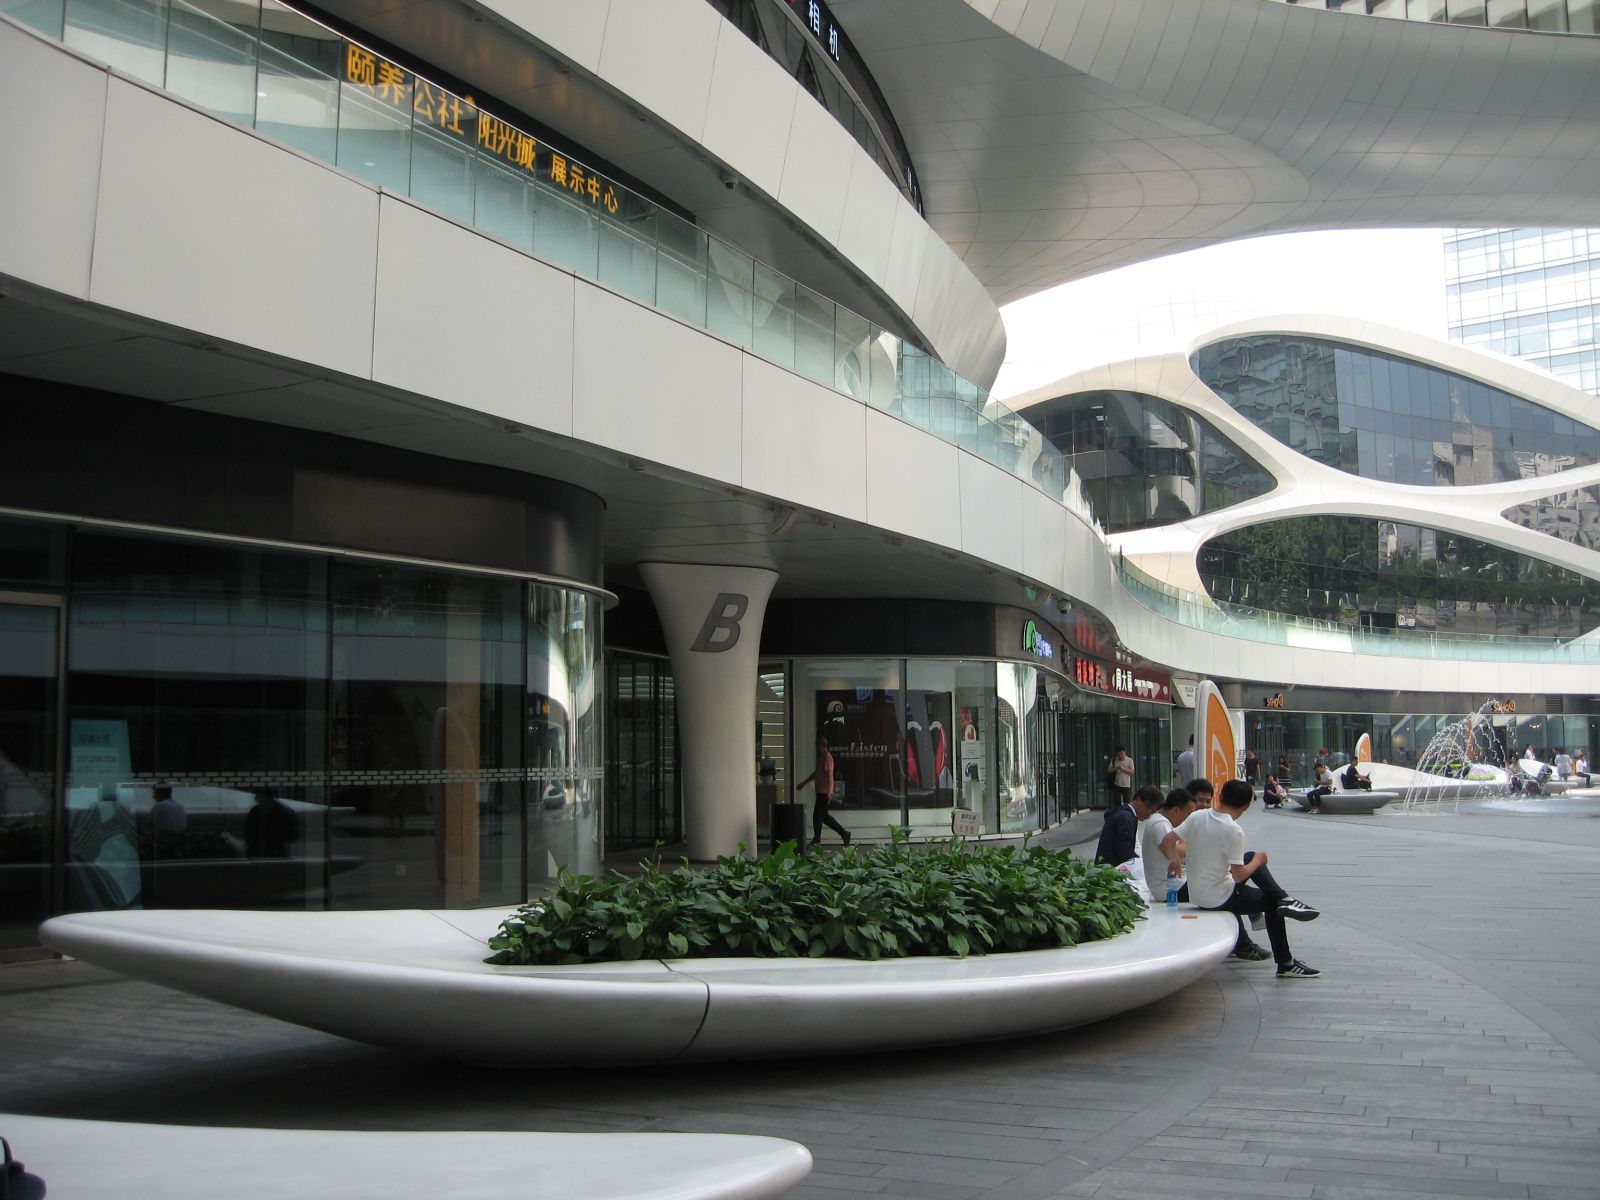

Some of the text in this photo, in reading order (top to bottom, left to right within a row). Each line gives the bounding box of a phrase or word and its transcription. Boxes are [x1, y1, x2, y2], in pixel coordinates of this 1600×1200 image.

[808, 0, 840, 62] 相机
[347, 43, 619, 214] 颐养公社 阳光城 展示中心
[689, 592, 749, 653] B
[850, 741, 888, 752] Listen
